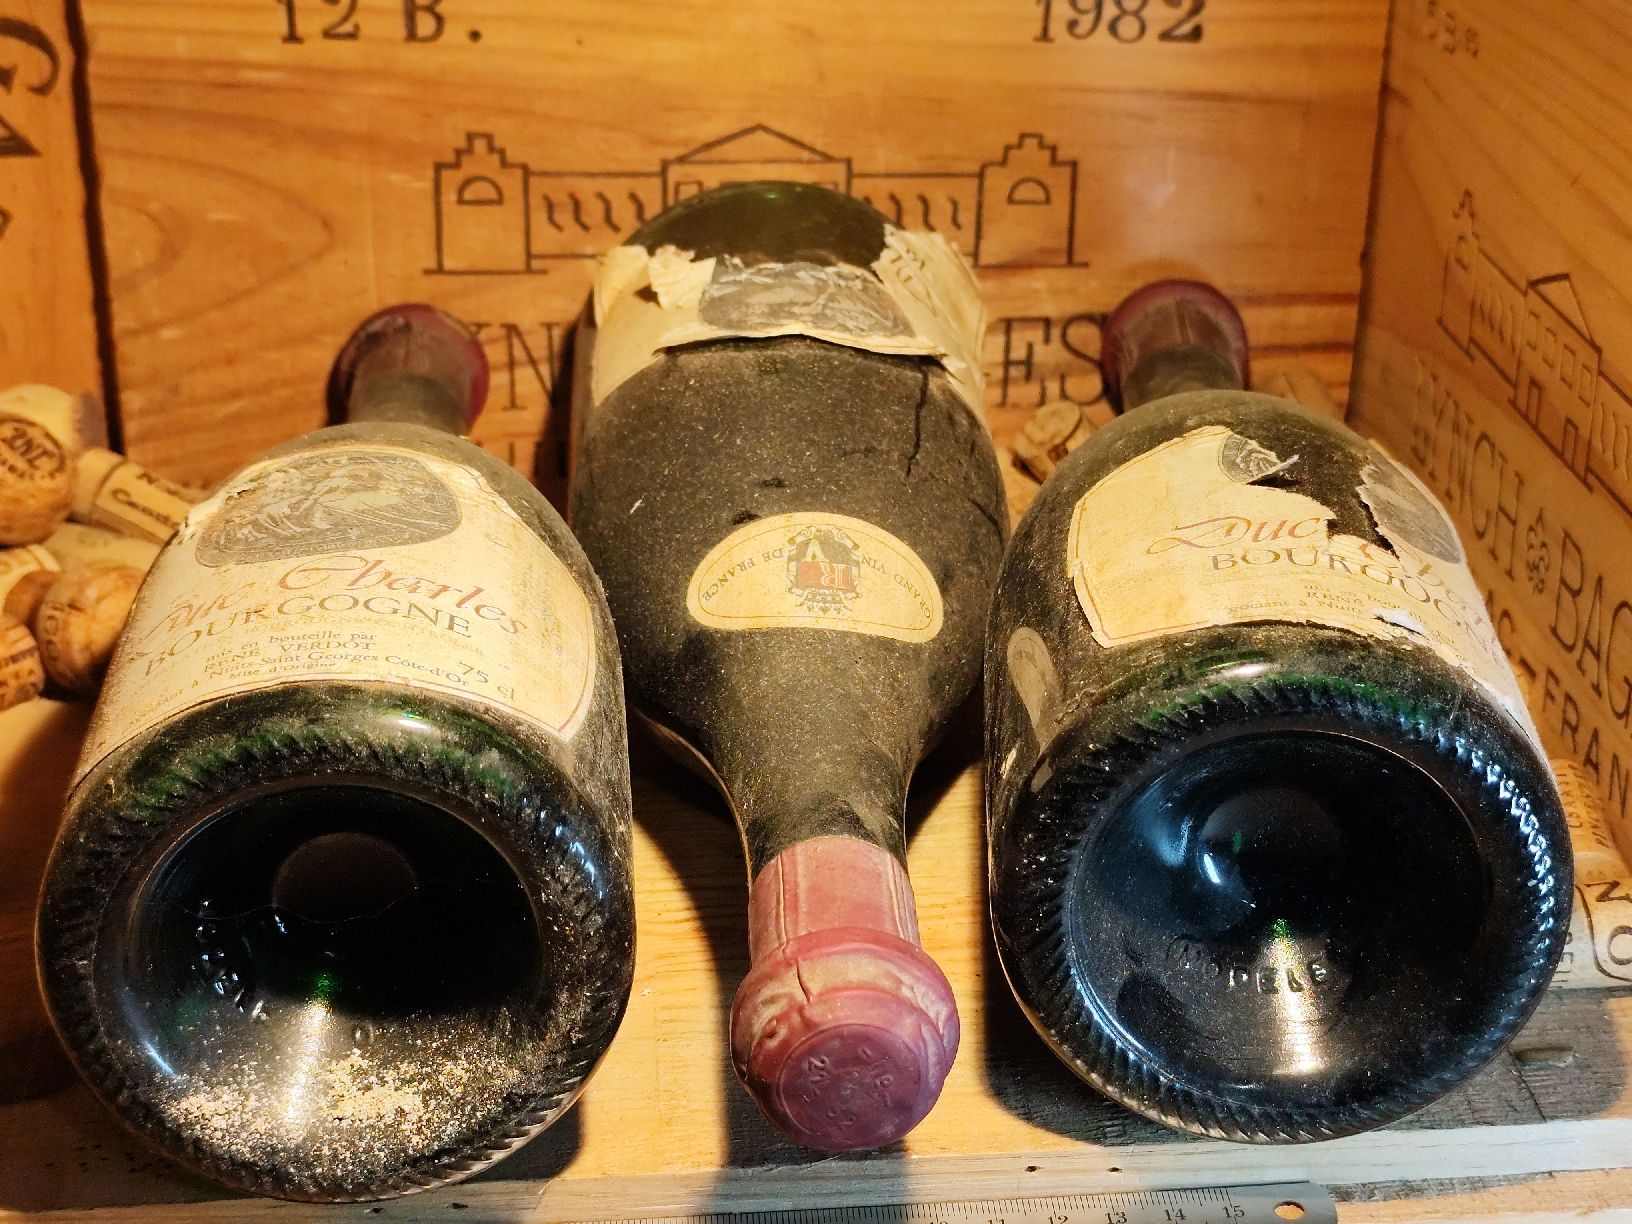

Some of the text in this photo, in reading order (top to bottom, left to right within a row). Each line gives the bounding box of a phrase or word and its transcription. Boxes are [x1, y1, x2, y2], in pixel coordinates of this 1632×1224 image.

[279, 0, 362, 44] 12
[1031, 0, 1206, 44] 1982
[1146, 515, 1324, 556] Duc
[277, 556, 528, 635] Charles
[701, 547, 932, 619] GRAND VIN DE FRANCE
[144, 594, 472, 679] BOURGOGNE
[269, 630, 342, 644] bouteille
[350, 632, 378, 642] par
[280, 641, 377, 653] VERDOT
[458, 660, 515, 701] 75 cl
[1104, 1211, 1128, 1224] 13
[1163, 1207, 1187, 1223] 14
[1221, 1203, 1246, 1220] 15
